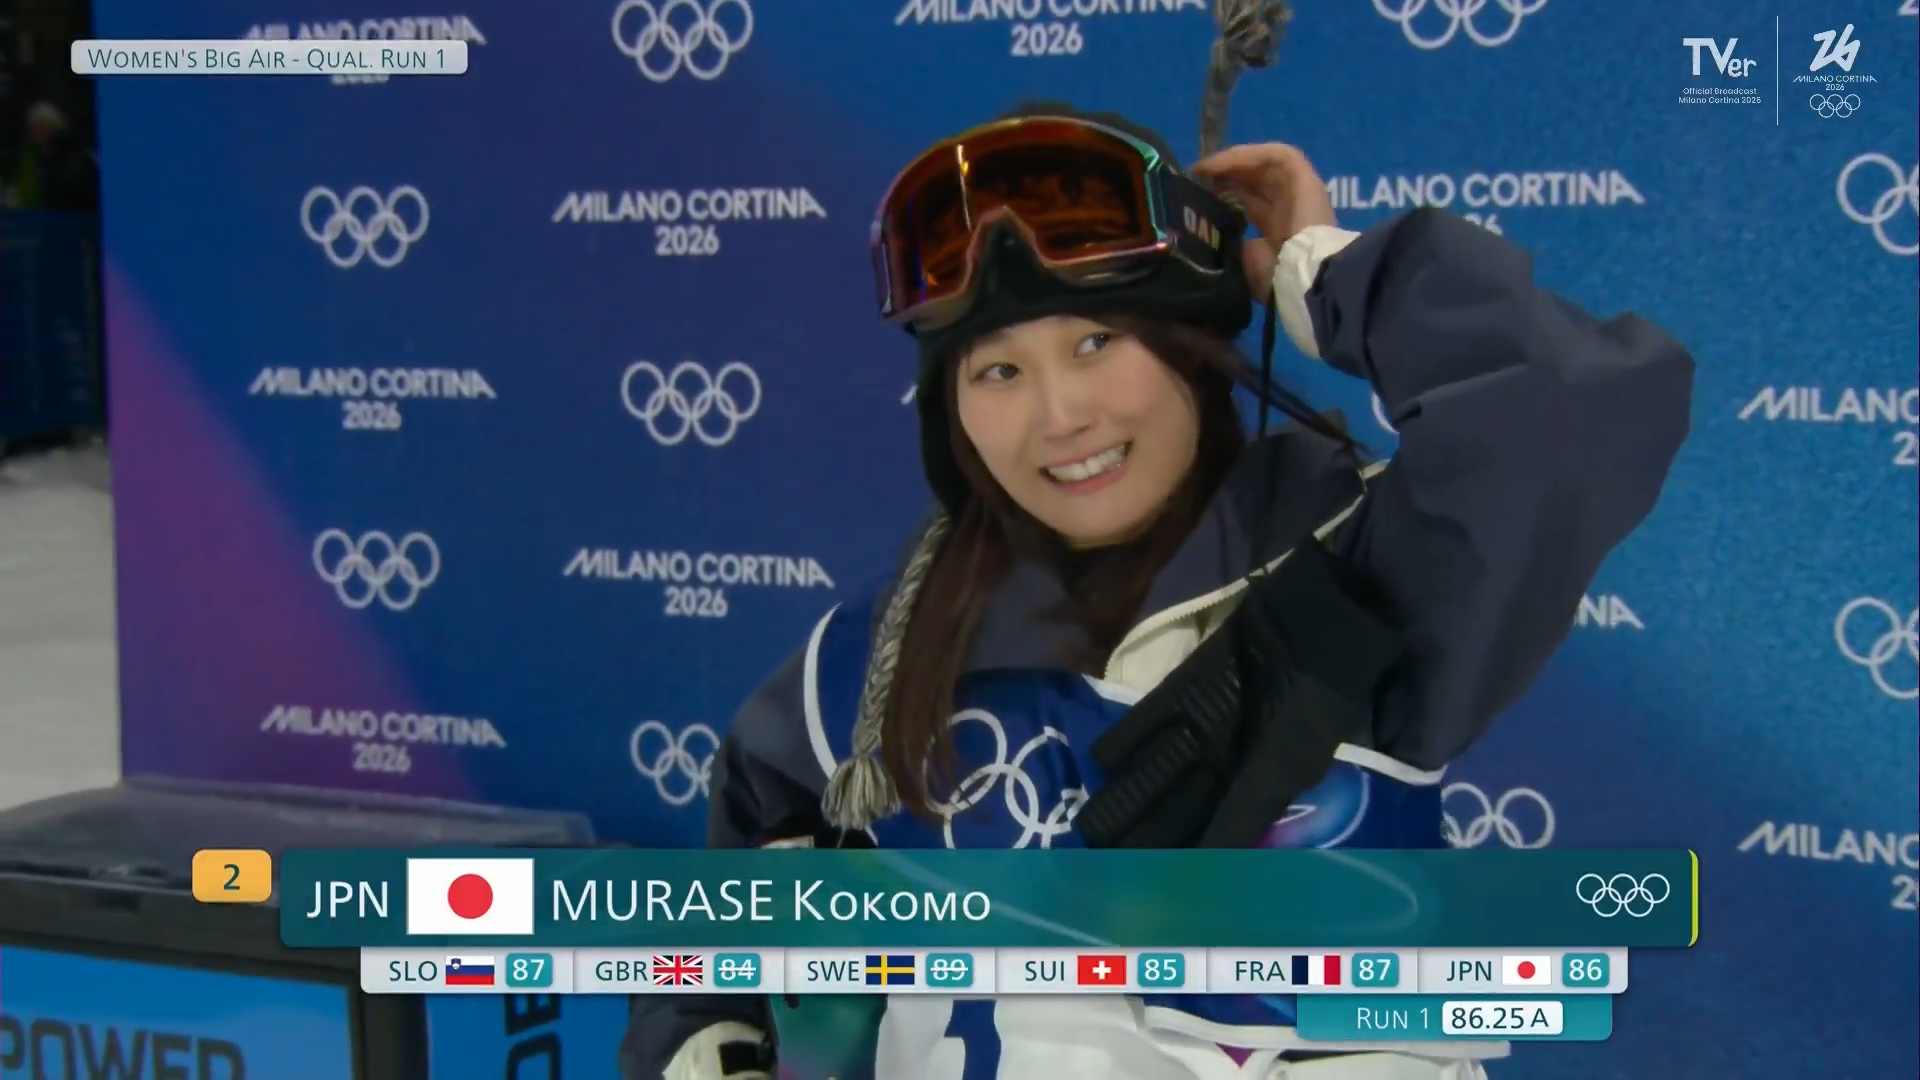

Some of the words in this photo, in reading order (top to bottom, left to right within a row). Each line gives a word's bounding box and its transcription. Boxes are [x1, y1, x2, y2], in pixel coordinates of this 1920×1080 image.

[1011, 22, 1083, 56] 2026
[552, 189, 683, 223] MILANO
[686, 187, 827, 220] CORTINA
[1462, 169, 1645, 208] CORTINA
[655, 224, 720, 256] 2026
[248, 366, 368, 398] MILANO
[370, 367, 498, 399] CORTINA
[342, 401, 402, 430] 2026
[563, 548, 692, 581] MILANO
[696, 553, 835, 588] CORTINA
[664, 586, 728, 617] 2026
[260, 704, 379, 739] MILANO
[380, 711, 508, 748] CORTINA
[353, 743, 412, 773] 2026
